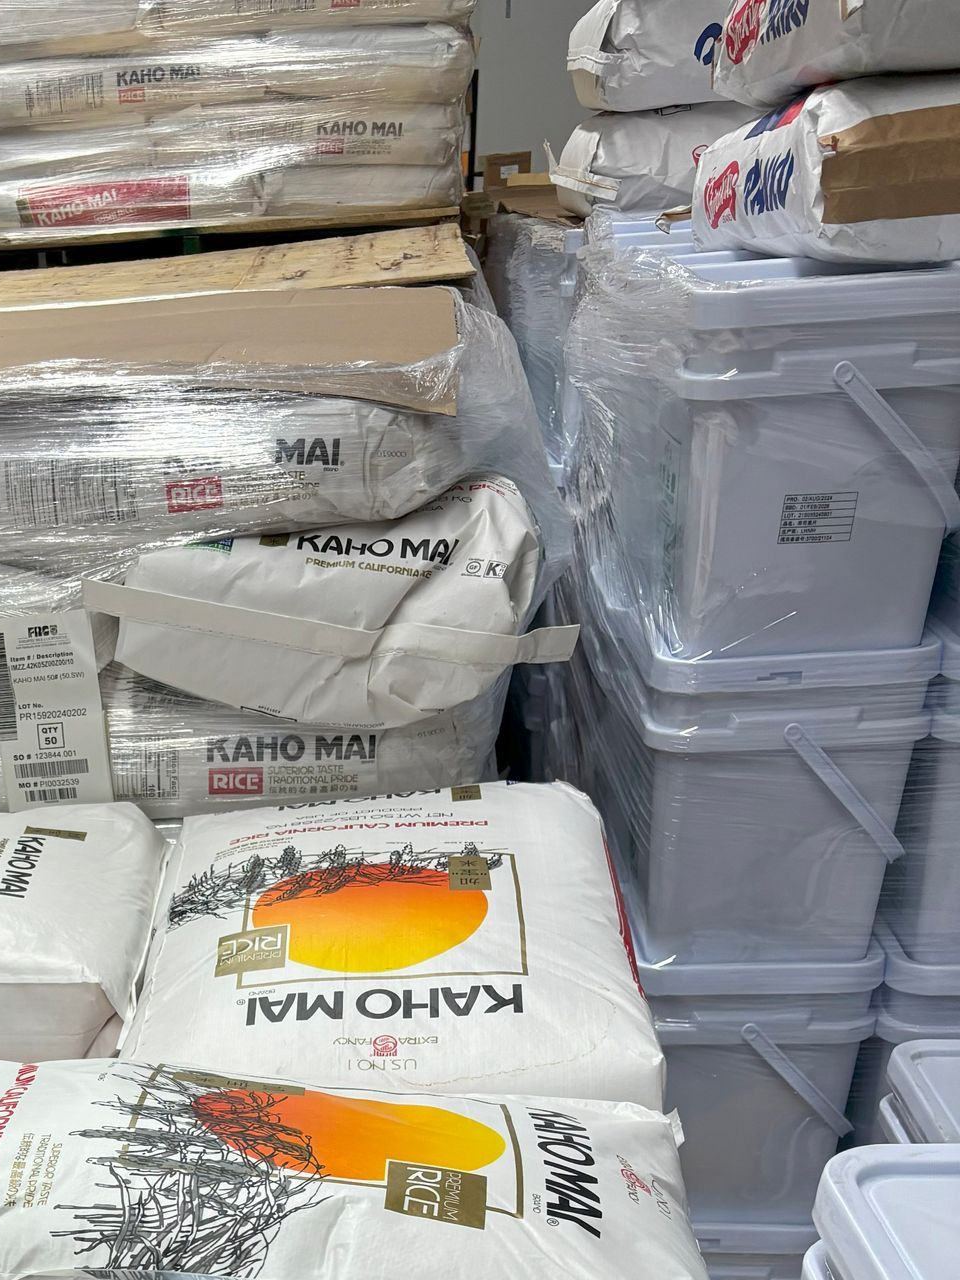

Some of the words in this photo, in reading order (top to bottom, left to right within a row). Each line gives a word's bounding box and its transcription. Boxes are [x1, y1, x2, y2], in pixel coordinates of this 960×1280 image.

[117, 67, 166, 86] KAHO
[317, 121, 367, 136] KAHO
[371, 122, 403, 137] MAI
[38, 201, 85, 226] KAHO
[275, 438, 340, 466] MAI
[297, 535, 395, 557] KAHO
[305, 558, 355, 569] PREMIUM
[20, 708, 86, 720] PR15920240202
[45, 737, 57, 745] 50
[206, 734, 305, 763] KAHO
[315, 734, 376, 763] MAI
[213, 774, 259, 790] RICE
[268, 766, 314, 775] SUPERIOR
[317, 765, 344, 774] TASTE
[268, 775, 328, 784] TRADITIONAL
[331, 774, 358, 783] PRIDE
[274, 821, 390, 837] CALIFORNIA
[394, 819, 488, 830] PREMIUM
[229, 832, 269, 846] RICE
[8, 836, 47, 870] KAHO
[221, 932, 282, 960] RICE
[219, 951, 282, 967] PREMIUM
[245, 990, 344, 1026] MAI
[356, 984, 524, 1019] KAHO
[333, 1036, 373, 1045] FANCY
[399, 1035, 438, 1045] EXTRA
[526, 1106, 596, 1167] KAHO
[402, 1167, 441, 1217] RICE
[444, 1171, 463, 1221] PREMIUM
[544, 1160, 603, 1239] MAI
